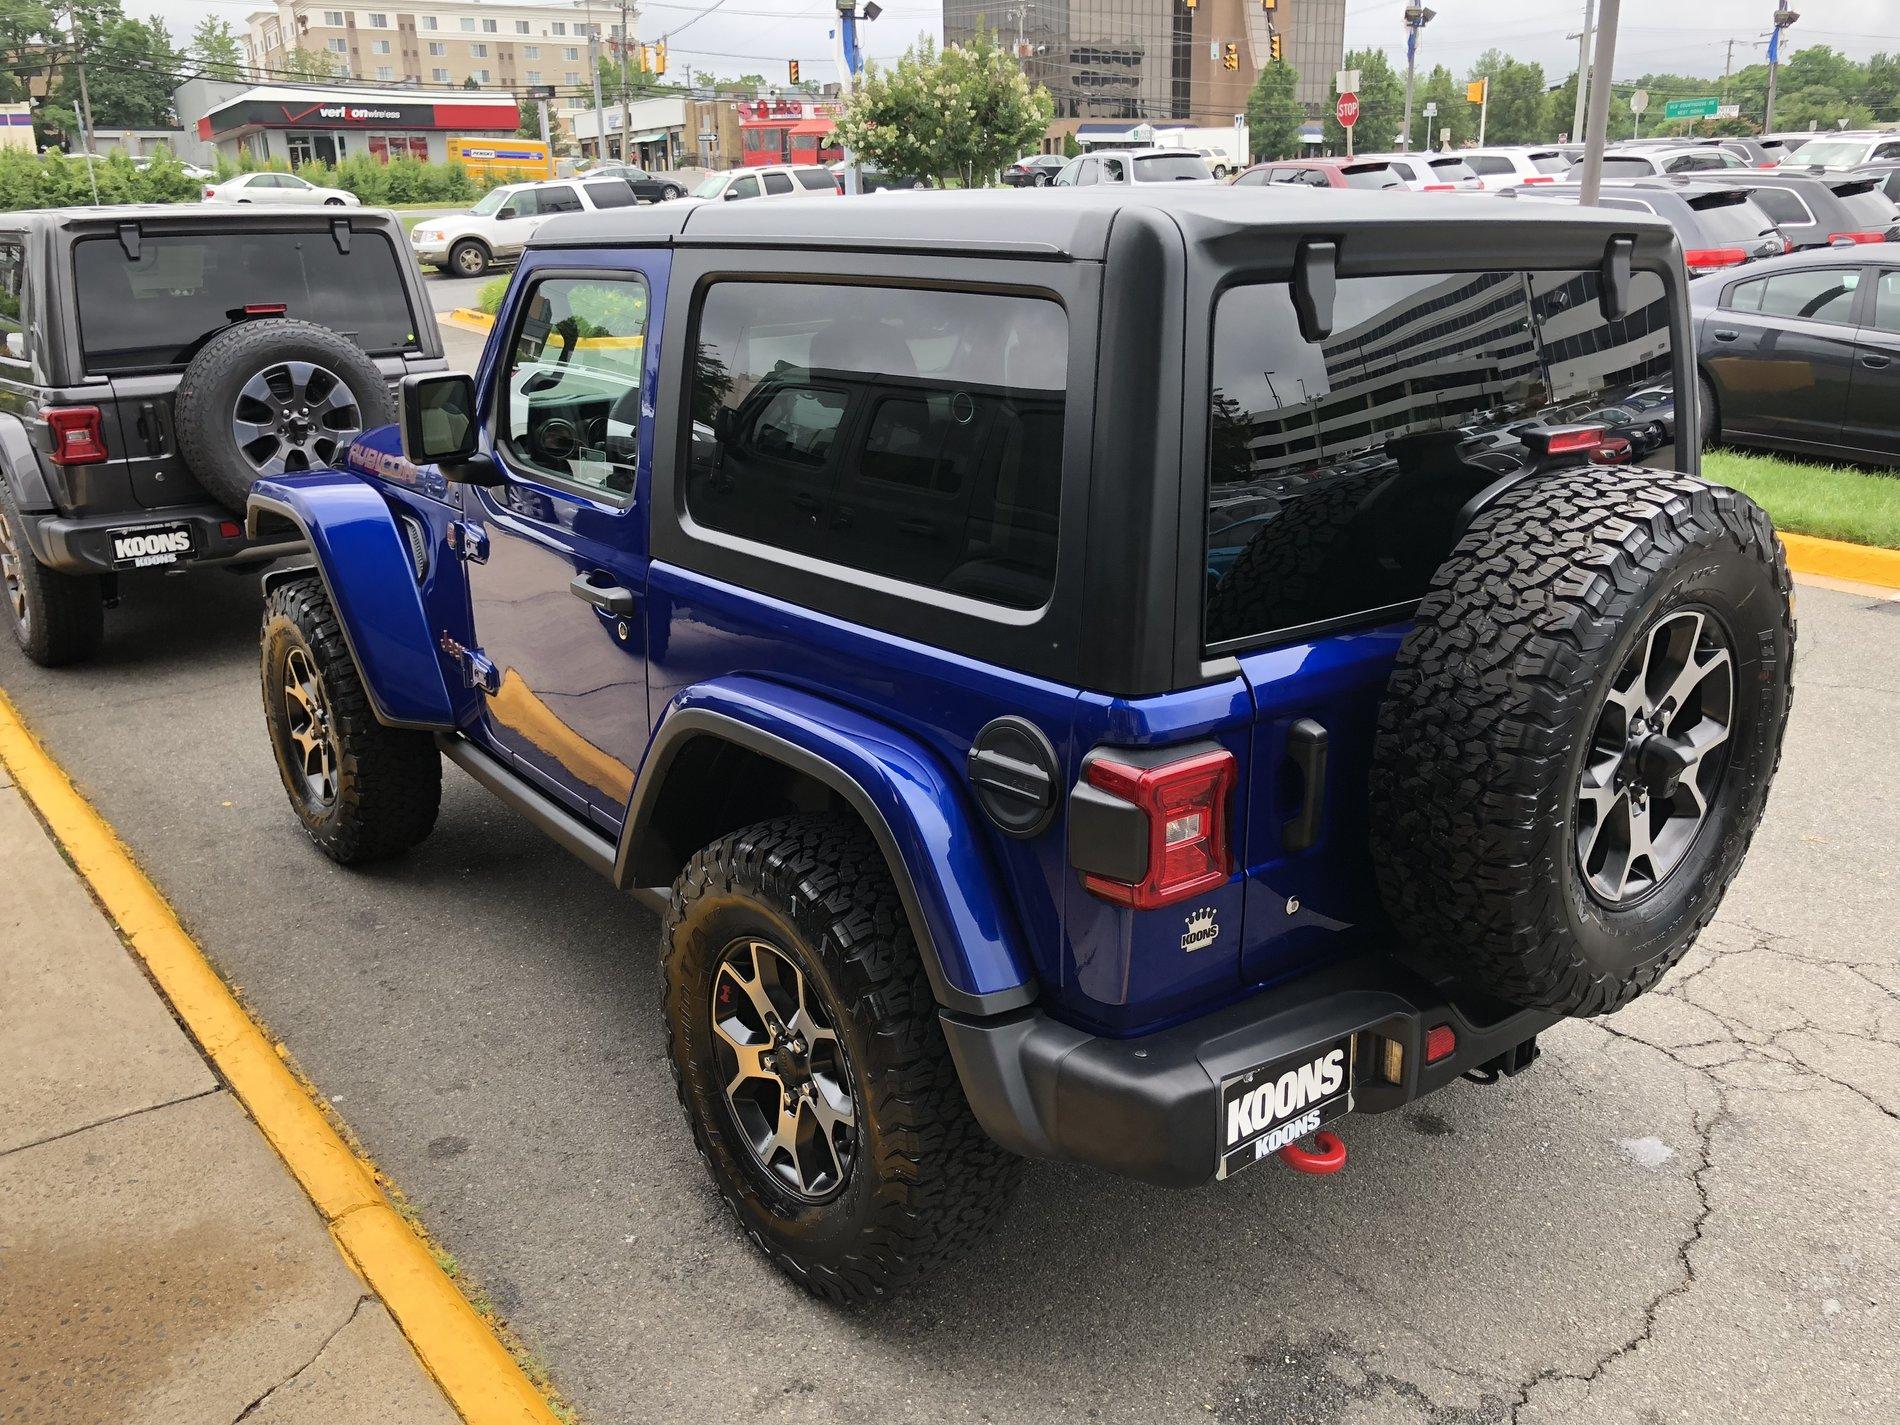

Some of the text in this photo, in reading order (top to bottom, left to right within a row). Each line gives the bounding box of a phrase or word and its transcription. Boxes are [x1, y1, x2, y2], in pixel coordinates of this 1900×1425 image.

[320, 106, 367, 118] verizon
[1339, 102, 1358, 117] STOP
[348, 442, 417, 484] RUBICON
[114, 531, 190, 559] KOONS
[134, 553, 177, 568] KOONS
[1182, 925, 1217, 946] KOONS
[1227, 1049, 1344, 1146] KOONS
[1256, 1109, 1321, 1160] KOONS
